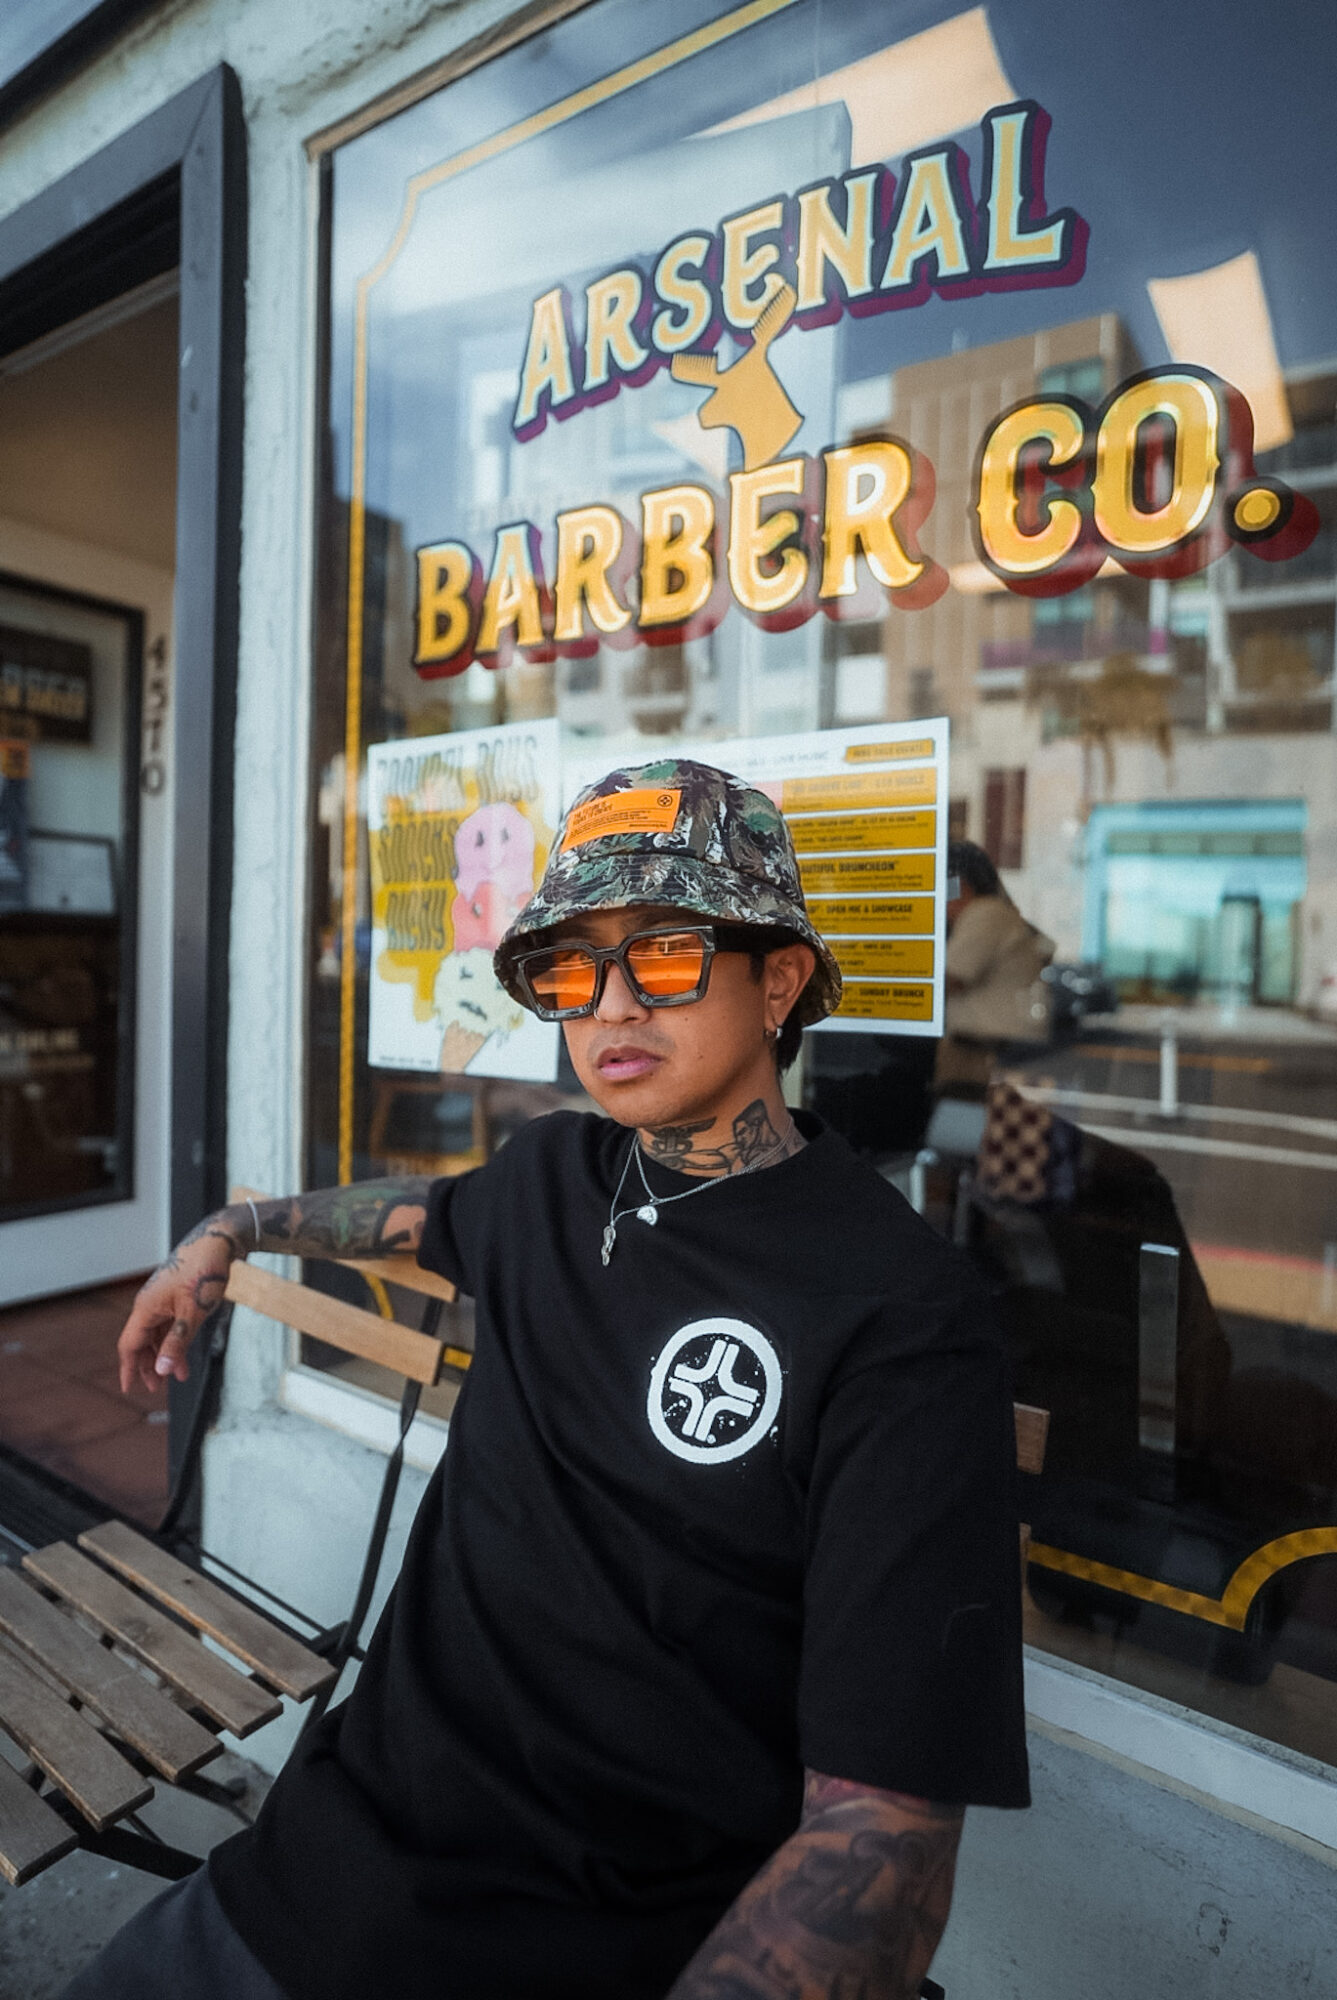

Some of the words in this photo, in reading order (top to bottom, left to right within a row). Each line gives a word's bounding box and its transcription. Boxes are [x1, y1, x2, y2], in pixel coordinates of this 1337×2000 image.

[512, 106, 1072, 432] ARSENAL
[414, 440, 926, 666] BARBER
[975, 372, 1284, 576] CO.
